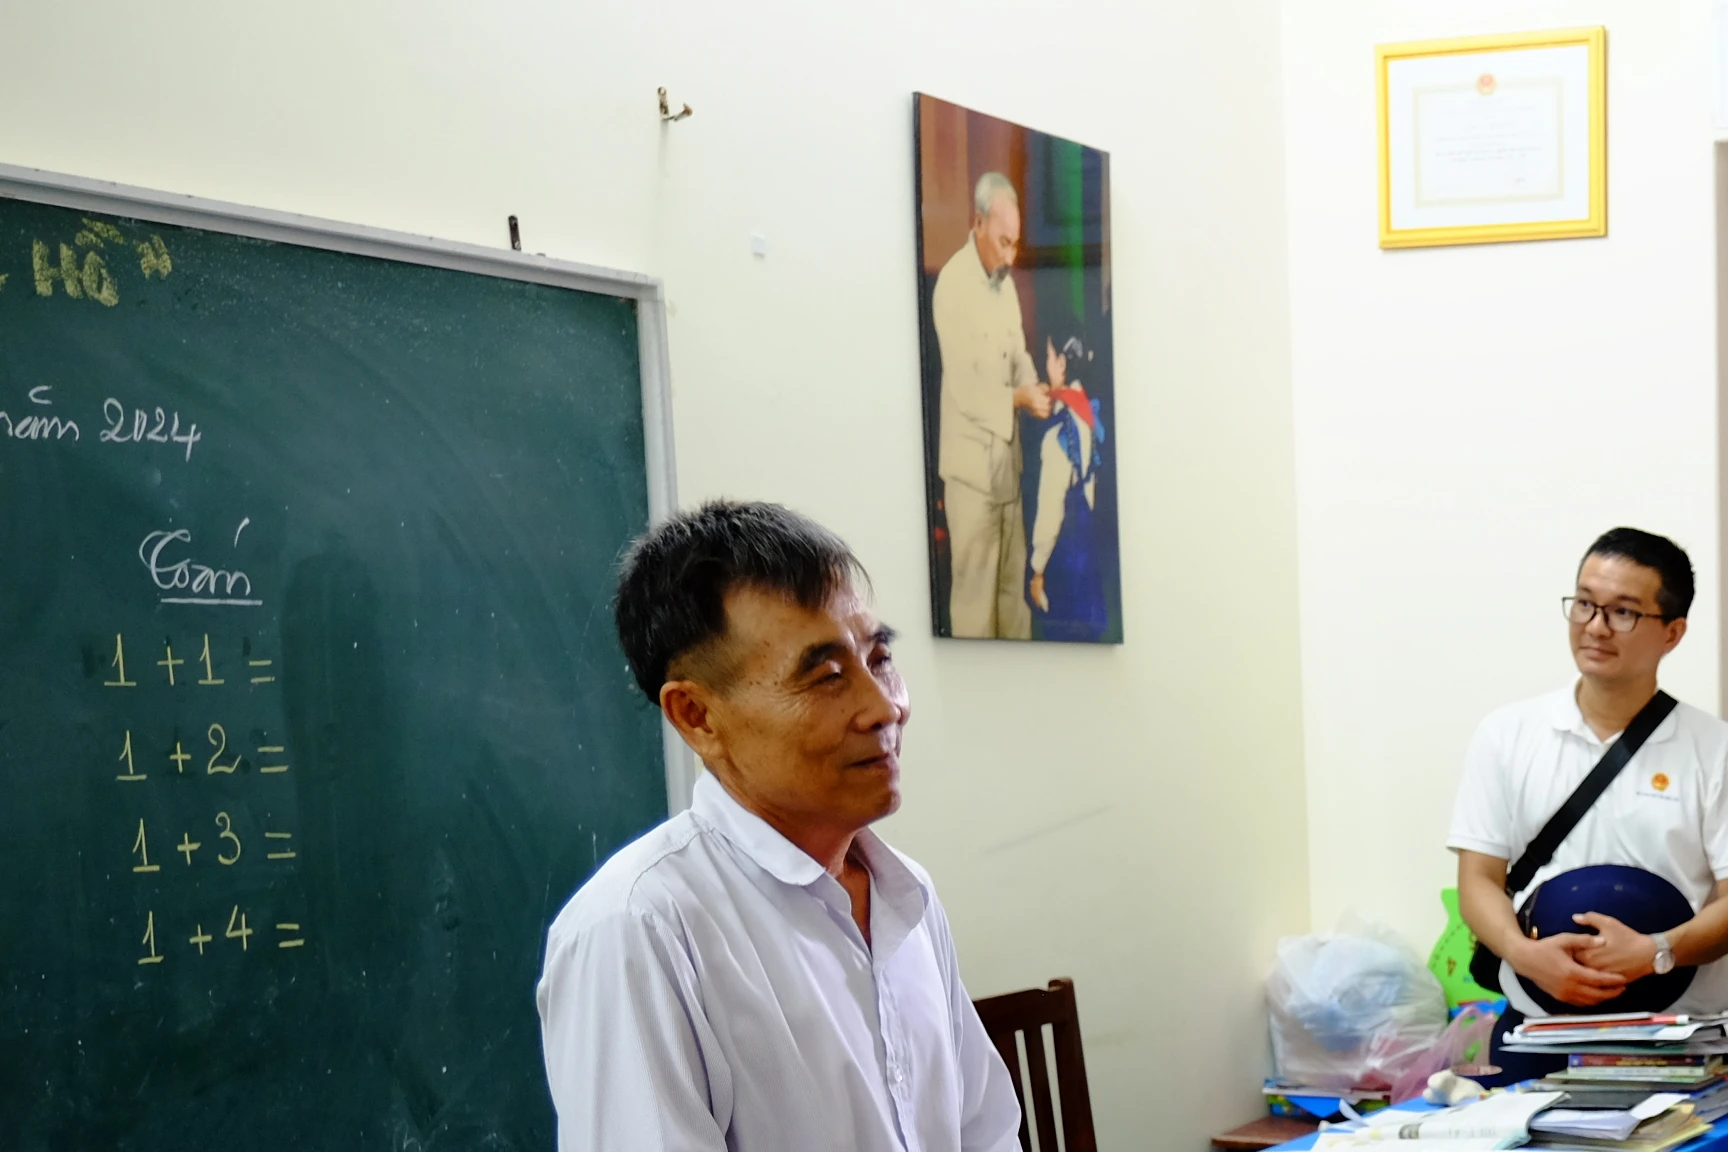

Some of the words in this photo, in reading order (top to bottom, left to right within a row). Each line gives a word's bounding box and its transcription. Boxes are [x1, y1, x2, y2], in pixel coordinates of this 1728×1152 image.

[100, 397, 202, 462] 2024
[104, 633, 137, 686] 1
[157, 646, 184, 686] +
[198, 633, 225, 685] 1
[115, 730, 147, 781] 1
[169, 741, 191, 773] +
[207, 723, 242, 775] 2
[132, 818, 160, 873] 1
[177, 832, 201, 865] +
[215, 811, 241, 865] 3
[138, 910, 164, 964] 1
[189, 924, 212, 955] +
[225, 904, 253, 951] 4
